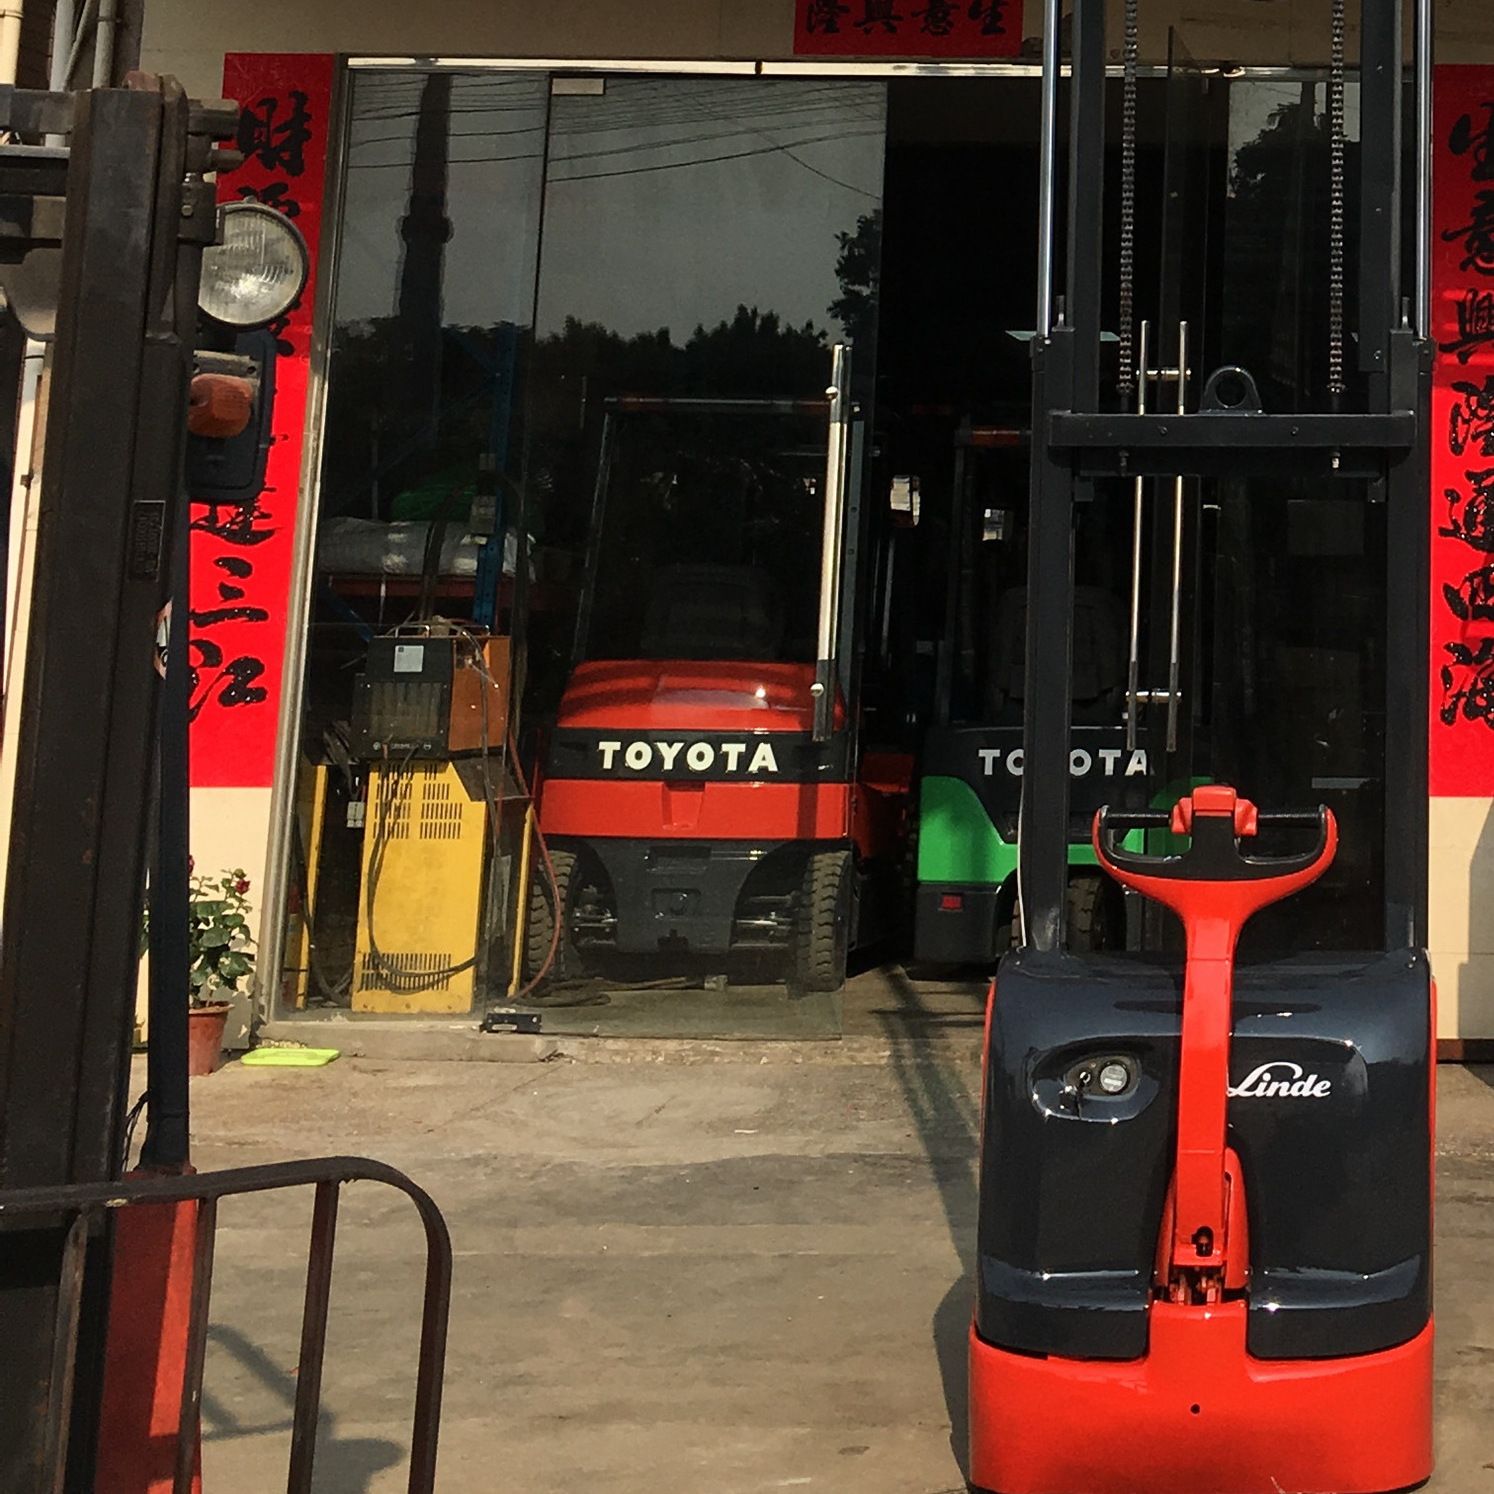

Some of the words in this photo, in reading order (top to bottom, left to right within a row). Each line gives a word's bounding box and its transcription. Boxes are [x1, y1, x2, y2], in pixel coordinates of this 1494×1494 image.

[597, 741, 779, 773] TOYOTA
[977, 748, 1156, 777] TOOTA
[1226, 1061, 1332, 1098] Linde
